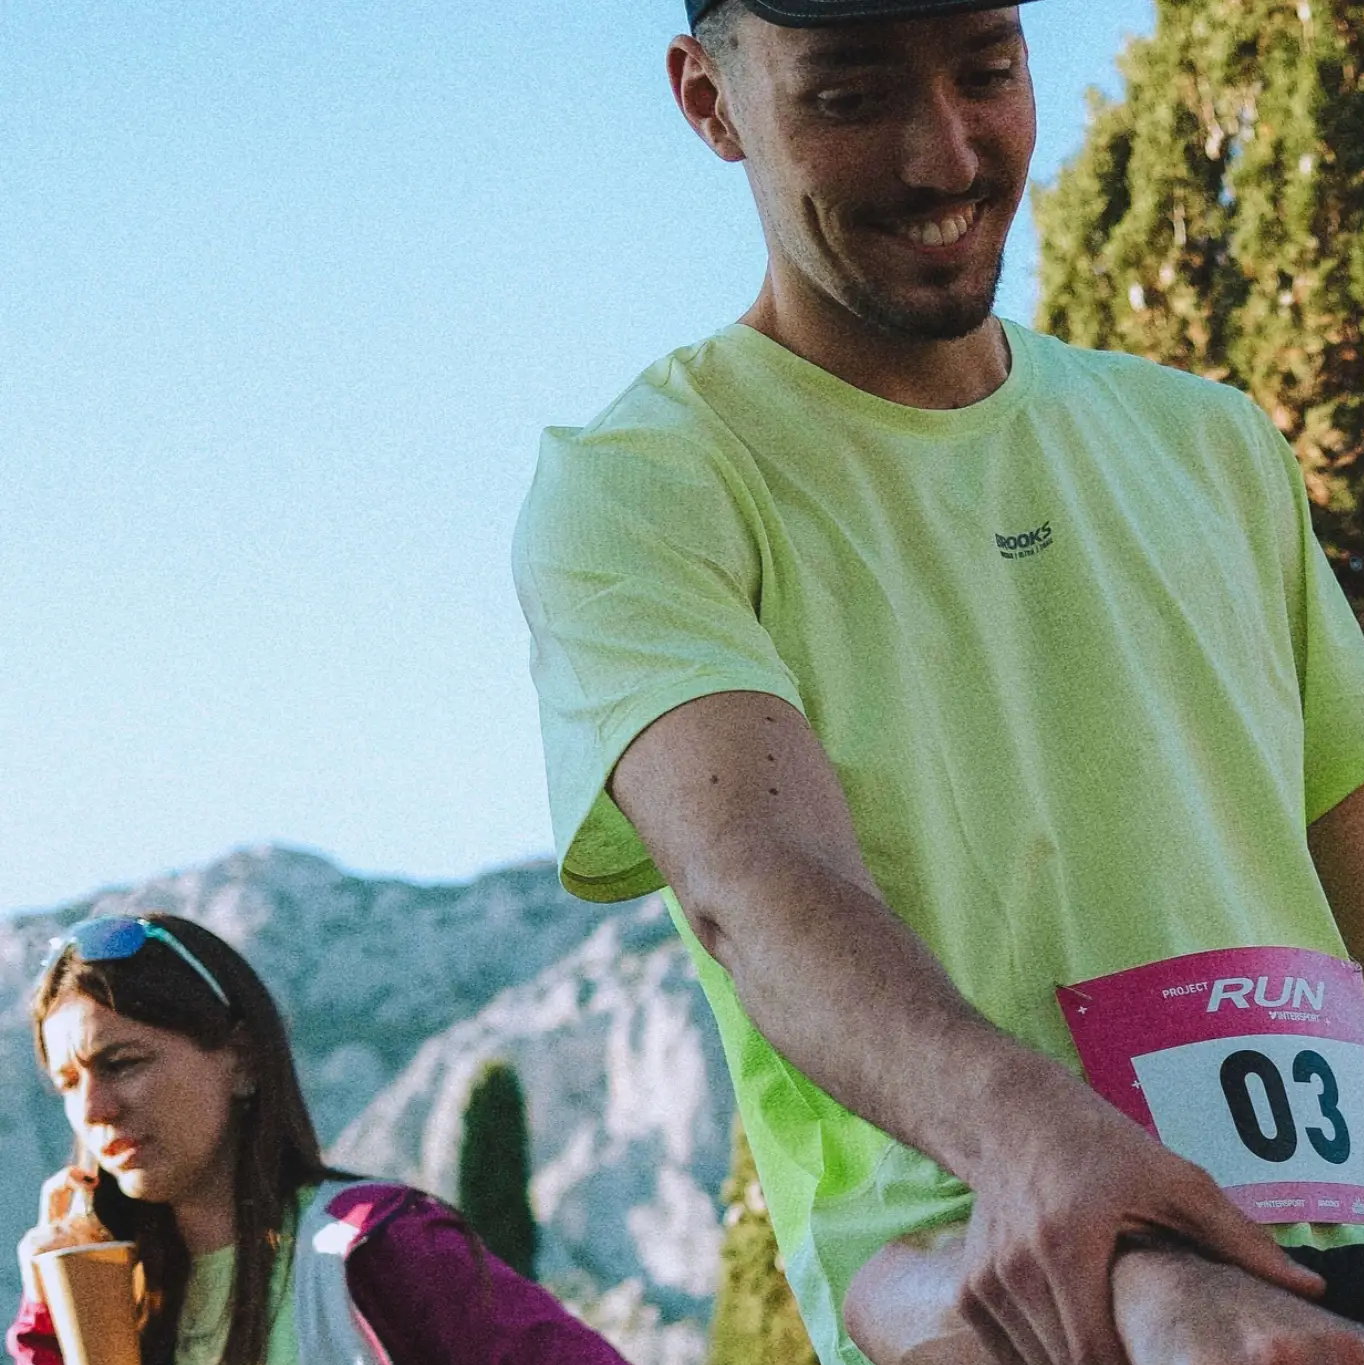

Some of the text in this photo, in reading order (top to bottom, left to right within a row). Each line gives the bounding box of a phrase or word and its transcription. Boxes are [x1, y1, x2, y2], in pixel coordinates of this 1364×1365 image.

[1162, 975, 1325, 1013] PROJECT RUN
[1219, 1049, 1351, 1165] 03
